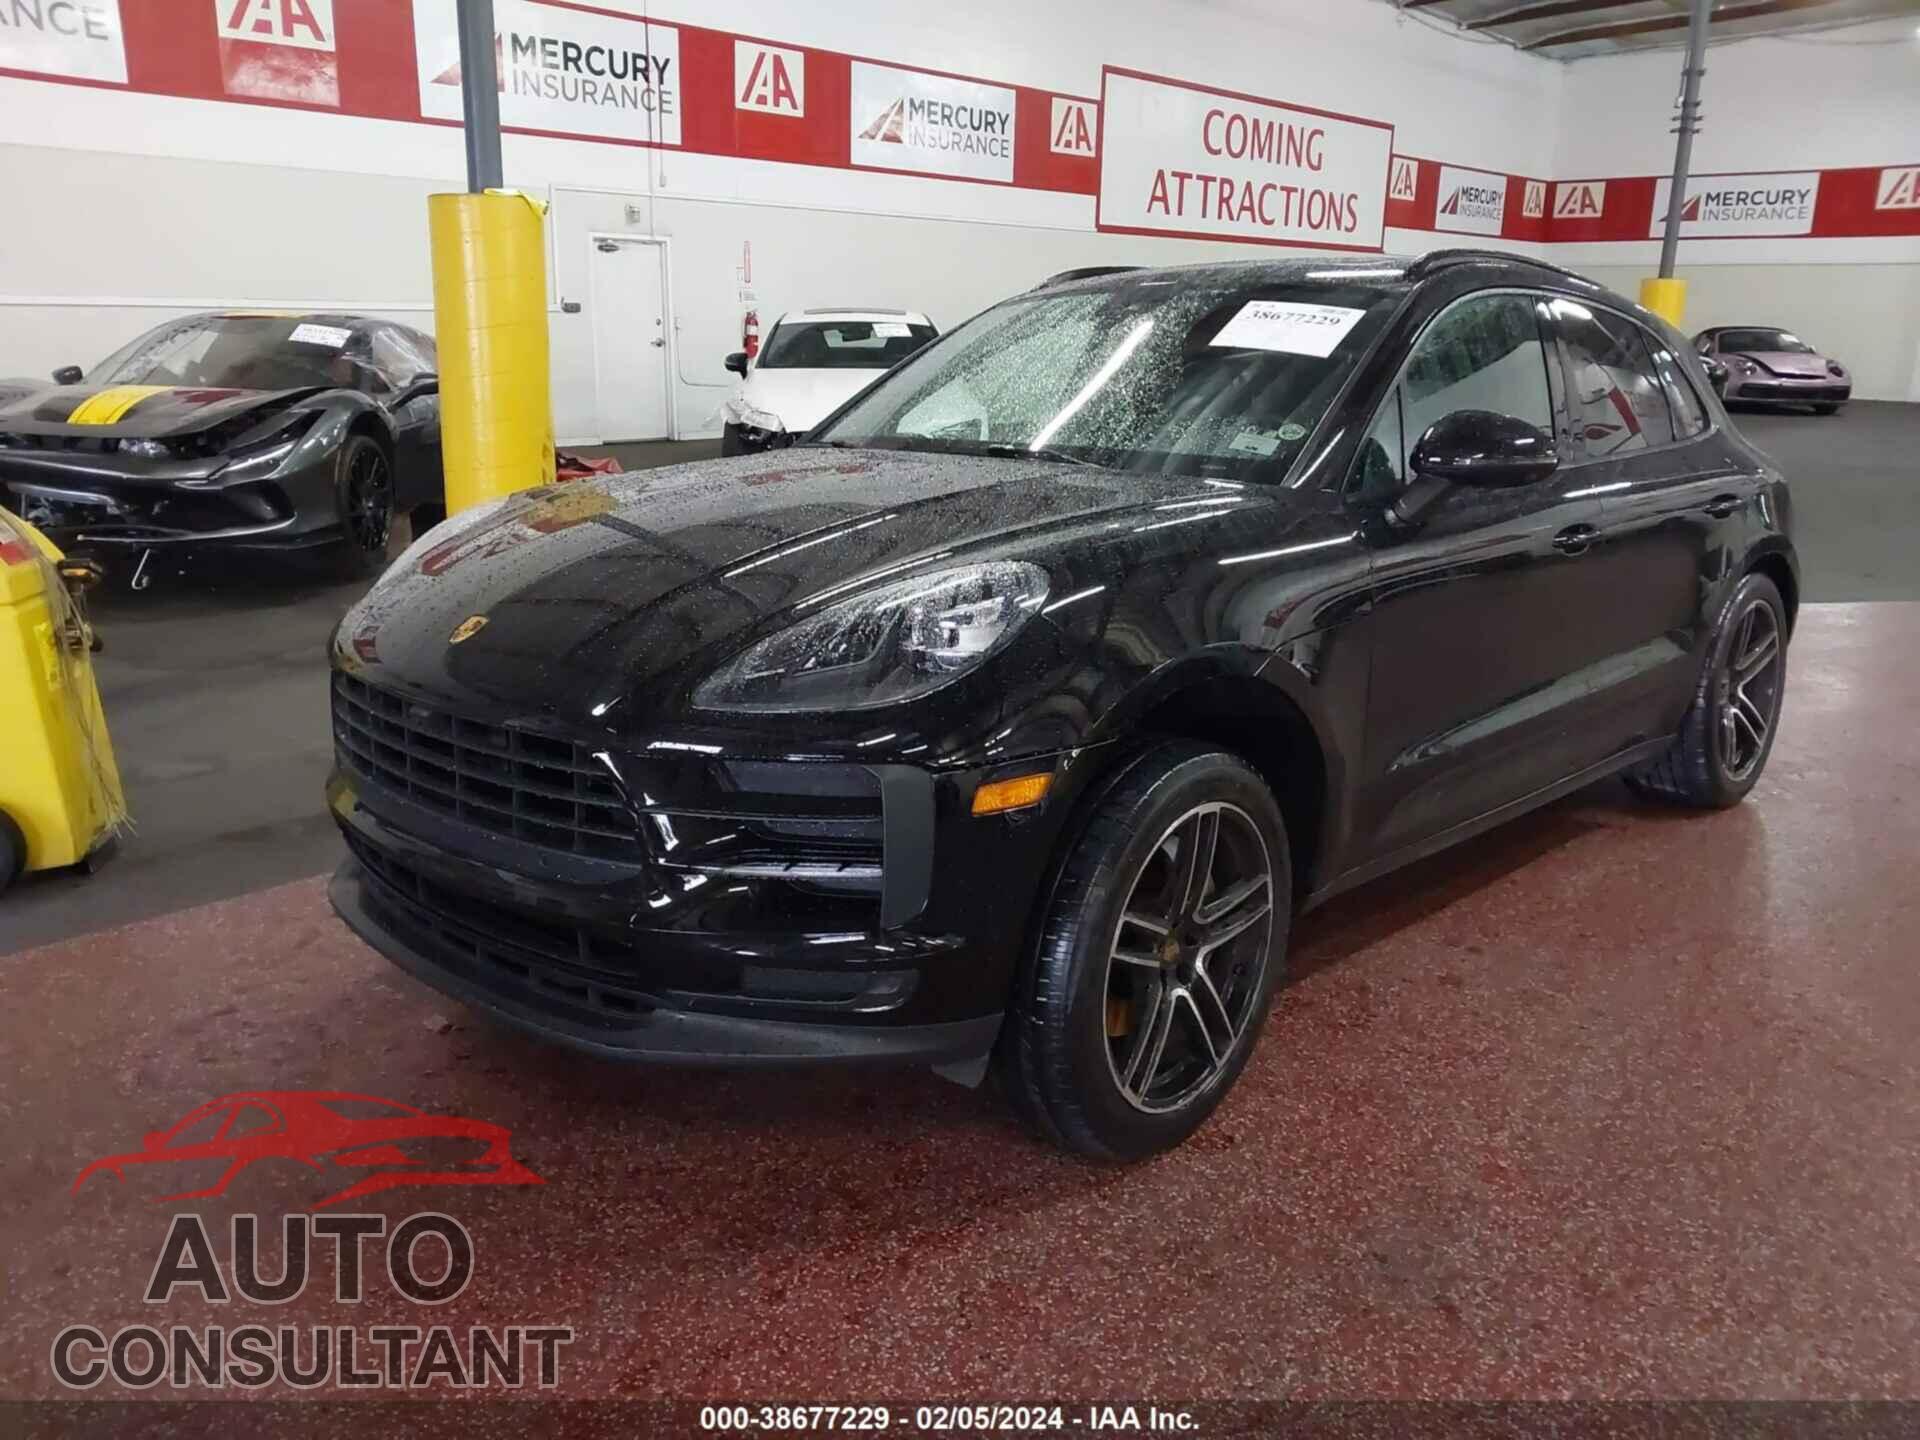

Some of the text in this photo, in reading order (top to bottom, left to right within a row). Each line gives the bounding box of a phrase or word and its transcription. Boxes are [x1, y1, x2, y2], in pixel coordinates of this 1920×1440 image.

[511, 32, 670, 86] MERCURY
[512, 68, 673, 114] INSURANCE
[908, 97, 1010, 135] MERCURY
[909, 125, 1010, 159] INSURANCE
[1203, 108, 1325, 171] COMING
[1147, 168, 1359, 233] ATTRACTIONS
[1459, 203, 1502, 221] INSURANCE
[1461, 185, 1503, 206] MERCURY
[1705, 189, 1811, 207] MERCURY
[1702, 206, 1809, 222] INSURANCE
